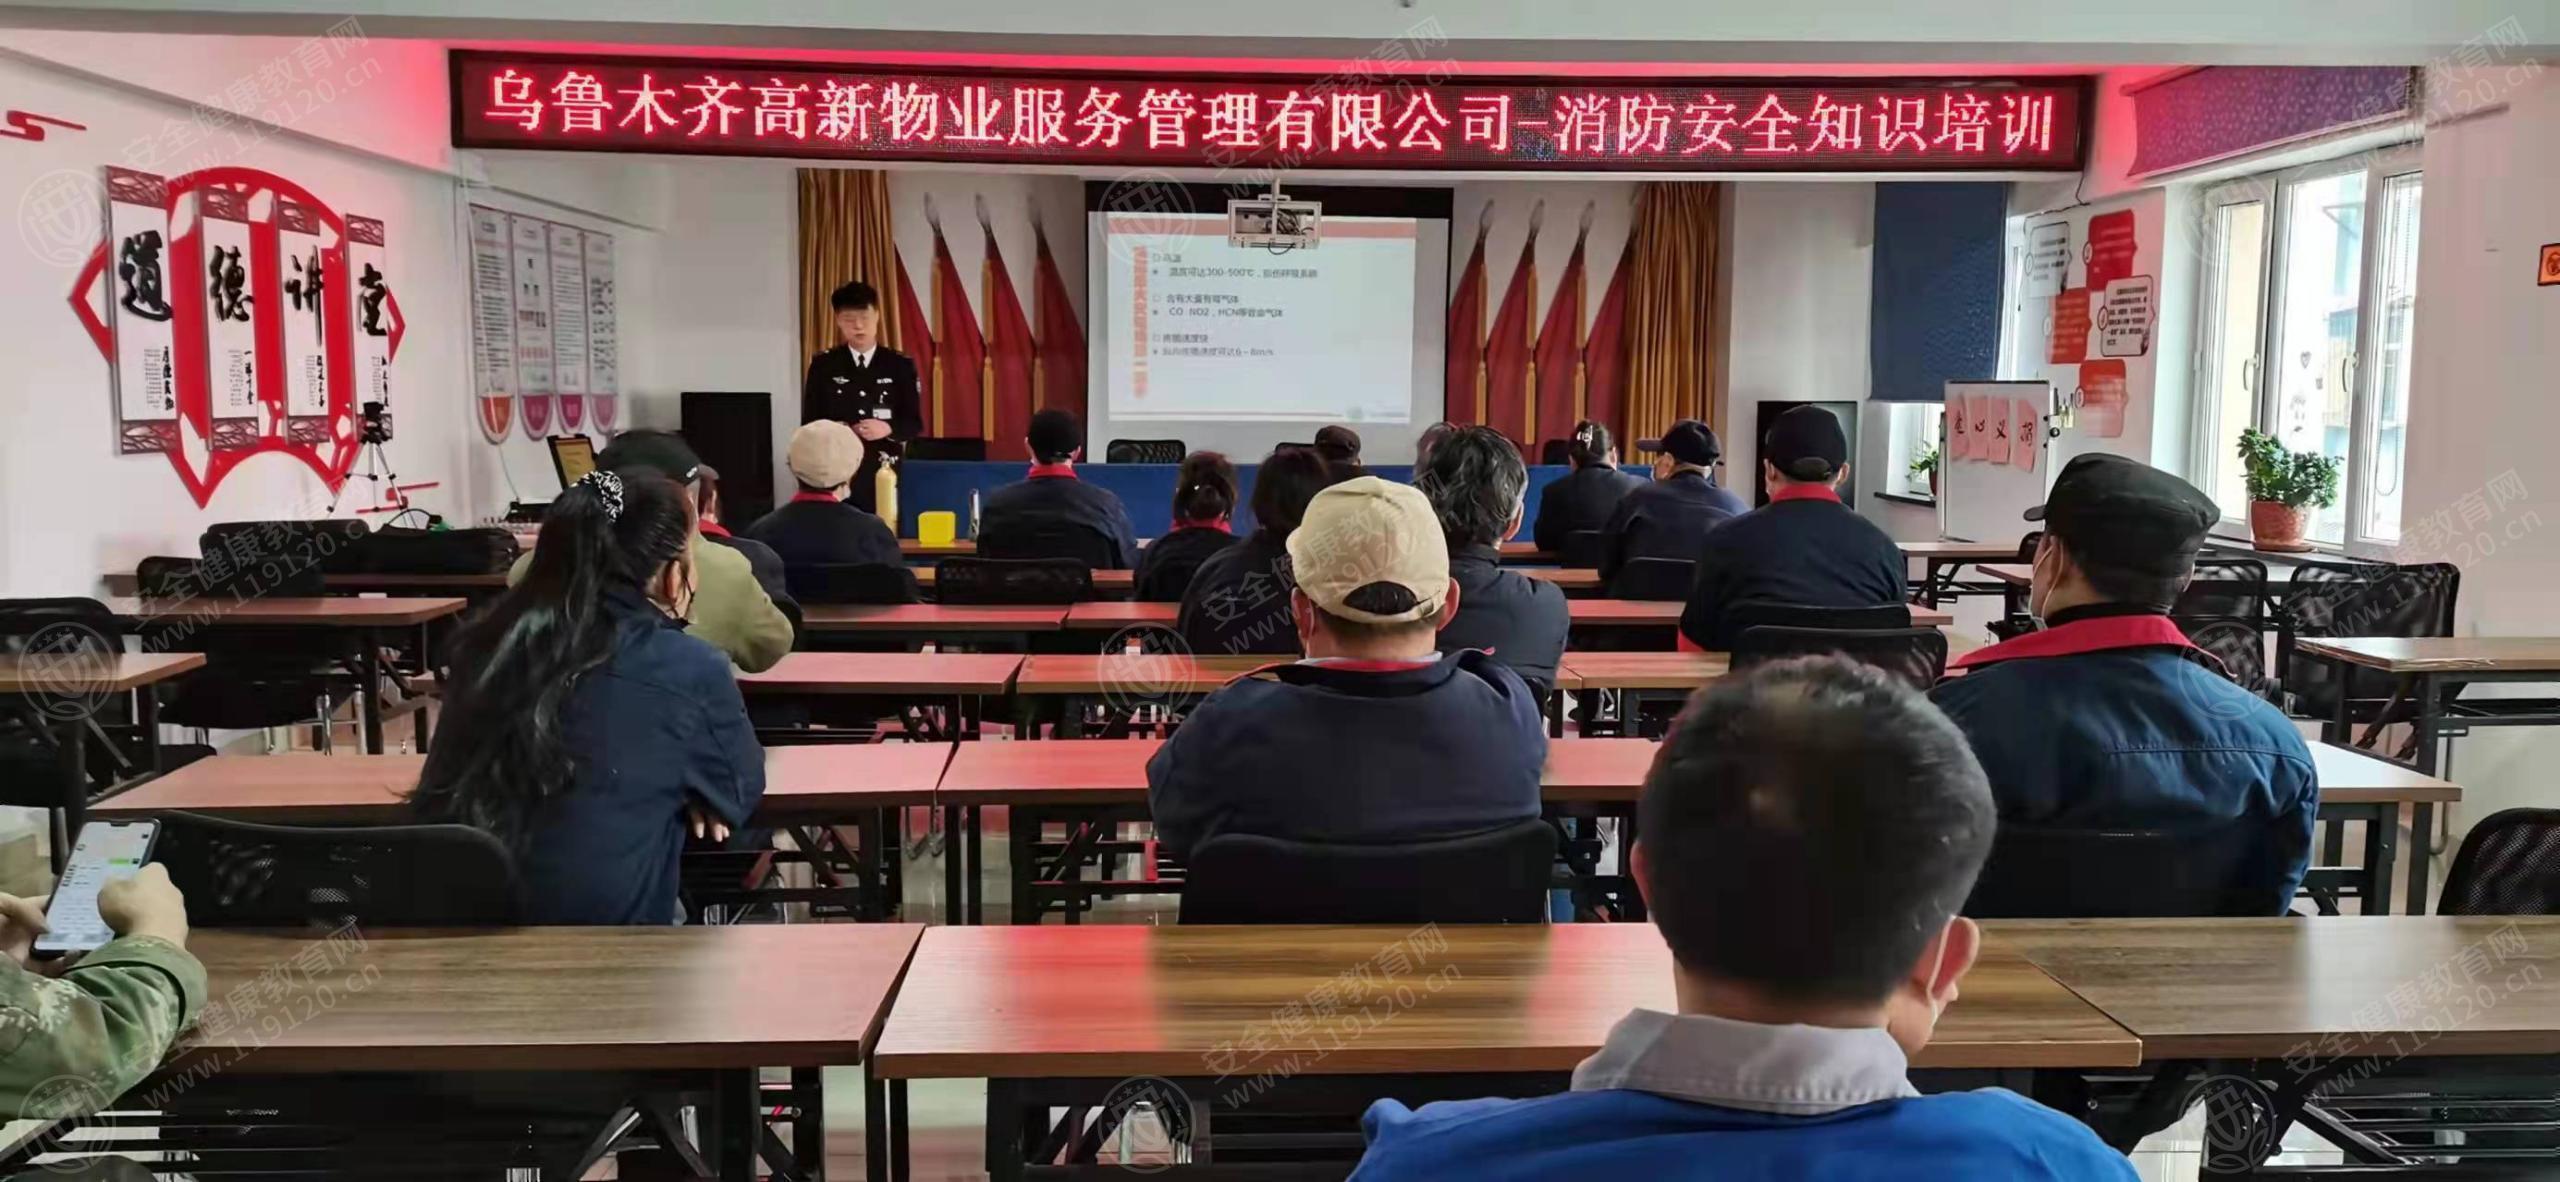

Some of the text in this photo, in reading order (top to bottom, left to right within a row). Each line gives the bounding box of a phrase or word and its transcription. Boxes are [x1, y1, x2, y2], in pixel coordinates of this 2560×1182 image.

[486, 69, 2056, 155] 乌鲁木齐高新物业服务管理有限公司-消防安全知识培训
